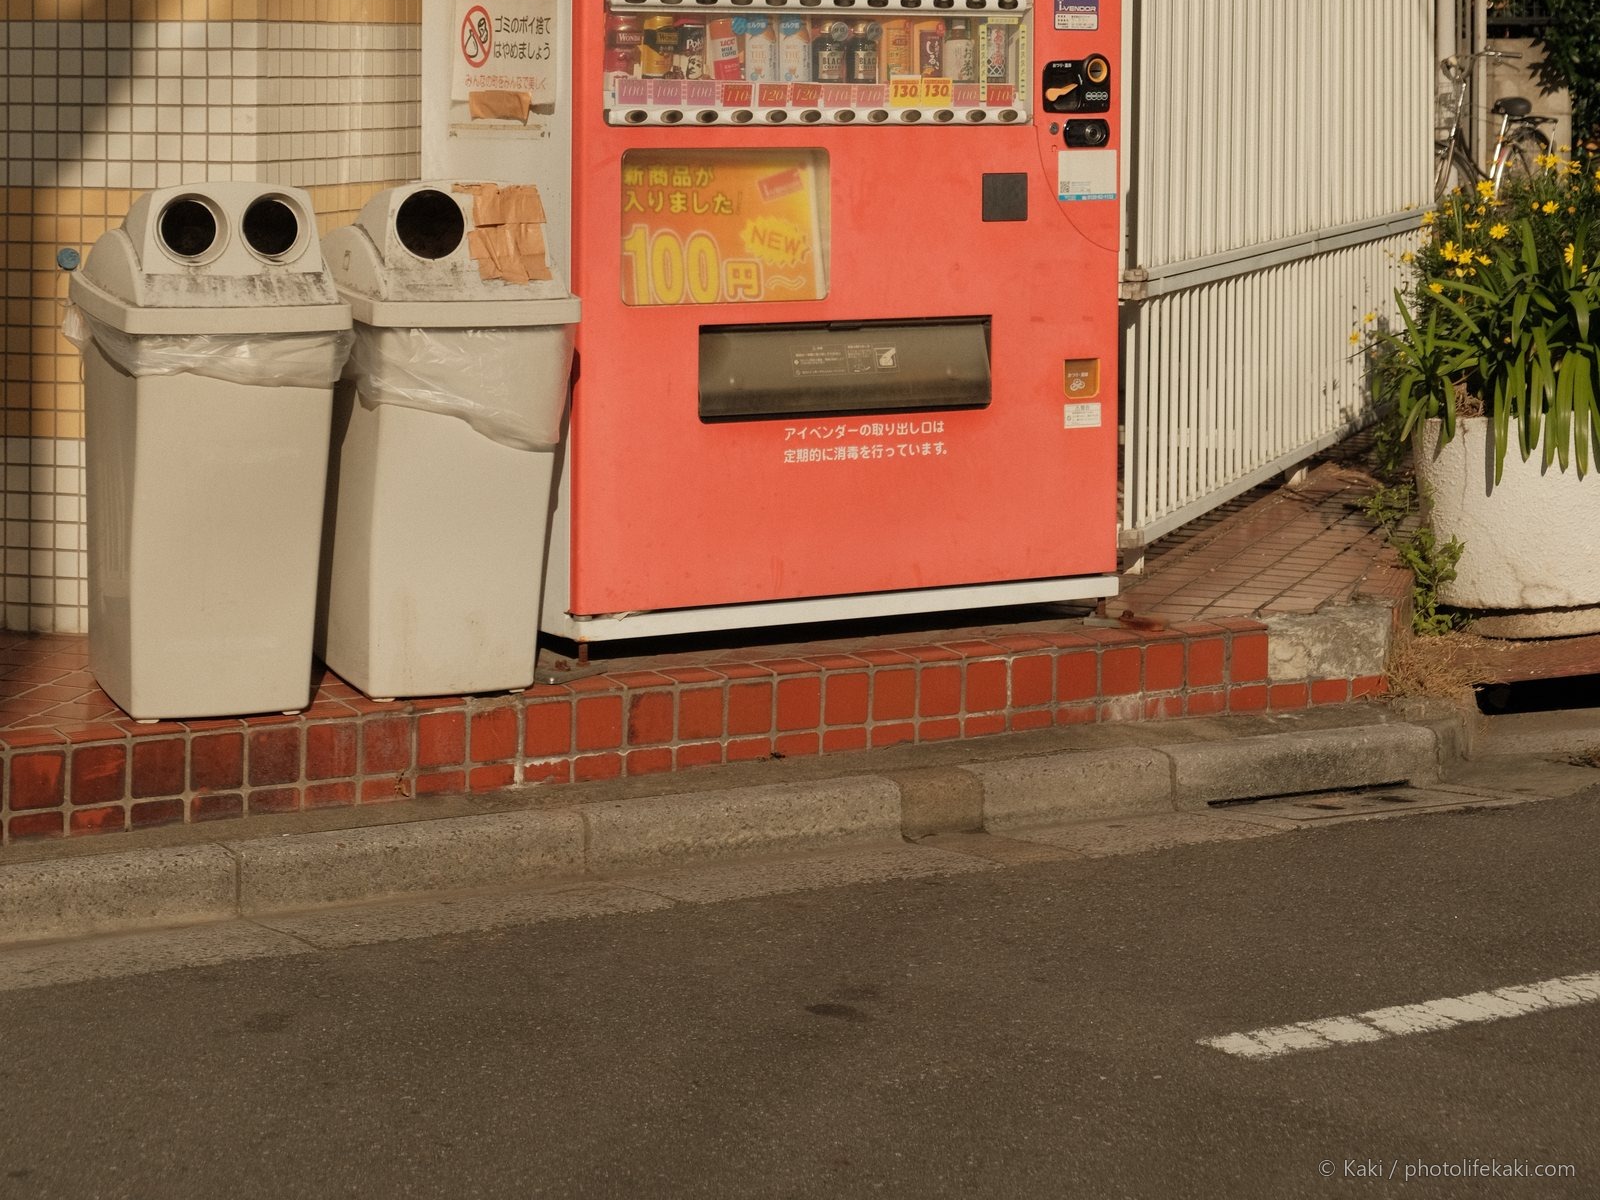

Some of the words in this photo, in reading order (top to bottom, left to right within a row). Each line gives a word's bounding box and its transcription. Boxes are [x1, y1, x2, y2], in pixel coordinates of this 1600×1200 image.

[494, 15, 551, 35] ゴミのポイ捨て
[493, 42, 551, 60] はやめましょう
[822, 57, 841, 65] BLAC
[859, 57, 876, 65] BLAC
[622, 85, 644, 97] 100
[657, 85, 679, 98] 100
[691, 86, 712, 98] 100
[727, 90, 749, 102] 110
[762, 89, 784, 101] 120
[796, 88, 817, 101] 120
[893, 85, 918, 98] 130
[925, 85, 949, 97] 130
[623, 166, 714, 188] 新商品が
[784, 420, 945, 441] アイベンダーの取り出し口は
[783, 441, 947, 464] 定期的に消毒を行っています。
